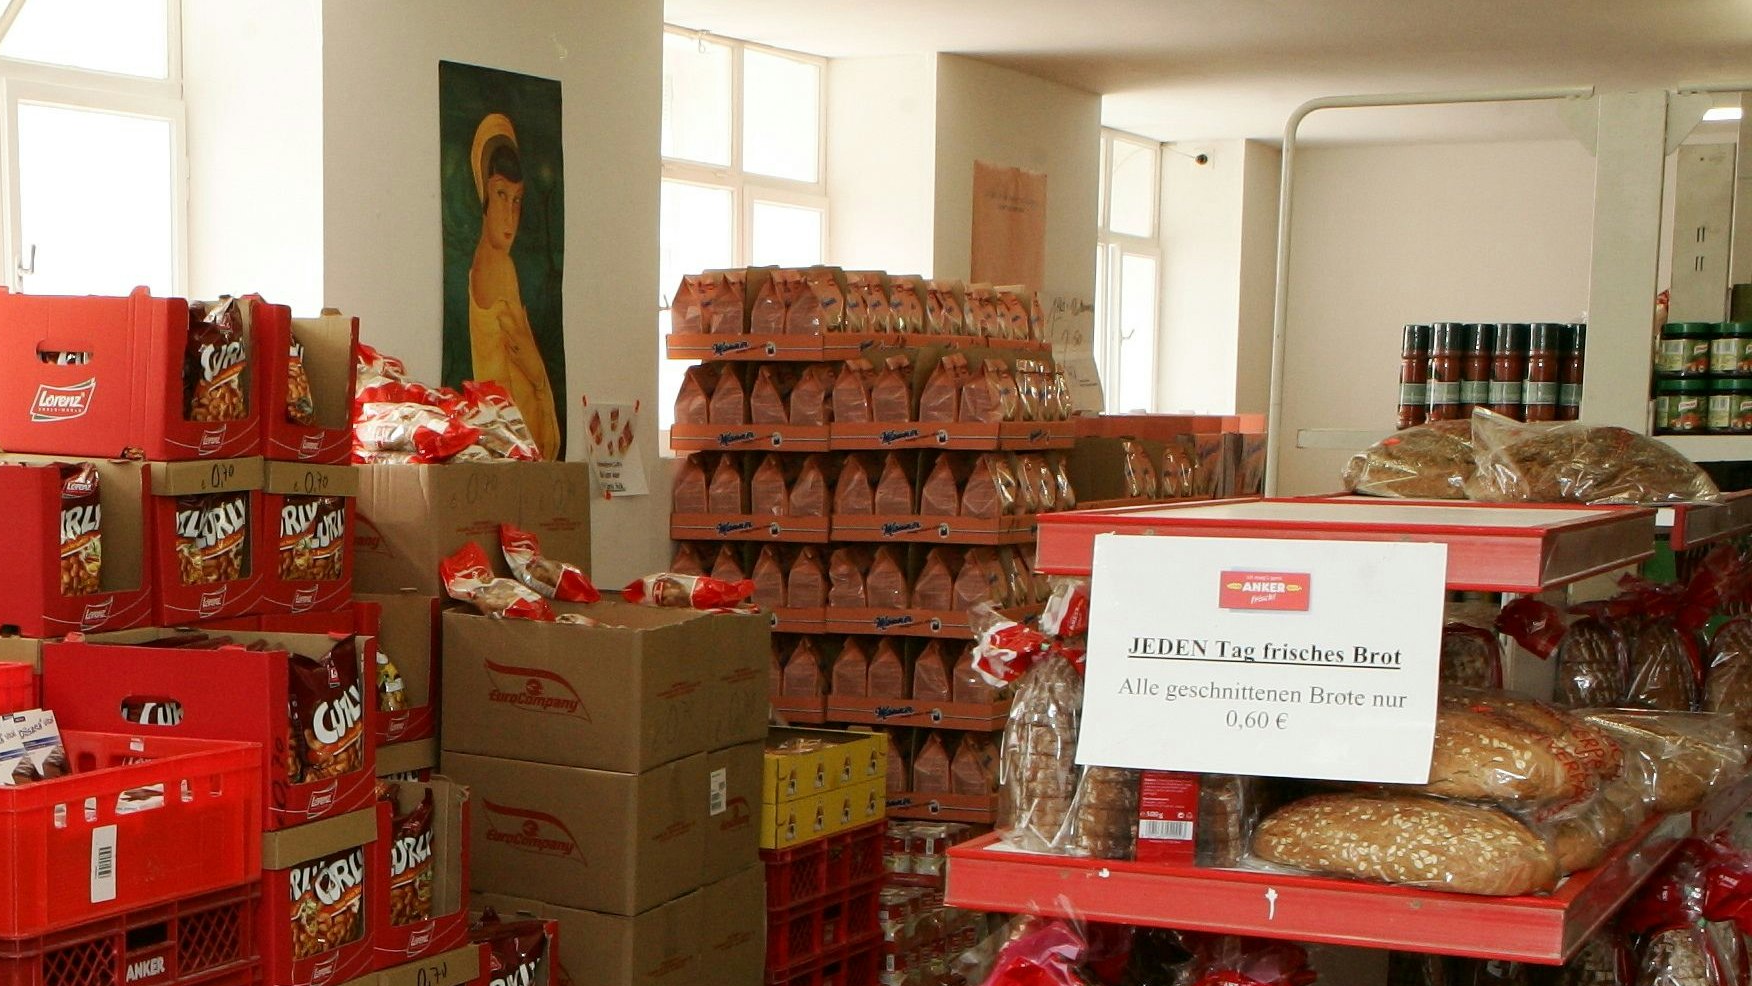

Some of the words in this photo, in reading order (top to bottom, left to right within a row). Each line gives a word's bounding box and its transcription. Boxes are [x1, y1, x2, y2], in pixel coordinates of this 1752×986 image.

[39, 389, 85, 408] Lorenz
[1242, 581, 1285, 594] ANKER
[1128, 636, 1207, 658] JEDEN
[1215, 639, 1256, 662] Tag
[1263, 641, 1345, 664] frisches
[1352, 645, 1402, 666] Brot
[487, 686, 581, 714] EuroCompany
[1118, 677, 1160, 696] Alle
[1165, 680, 1302, 705] geschnittenen
[1309, 685, 1366, 708] Brote
[1372, 693, 1408, 709] nur
[1225, 709, 1269, 731] 0,60
[1275, 712, 1289, 730] €
[485, 828, 575, 855] EuroCompany
[125, 956, 166, 982] ANKER
